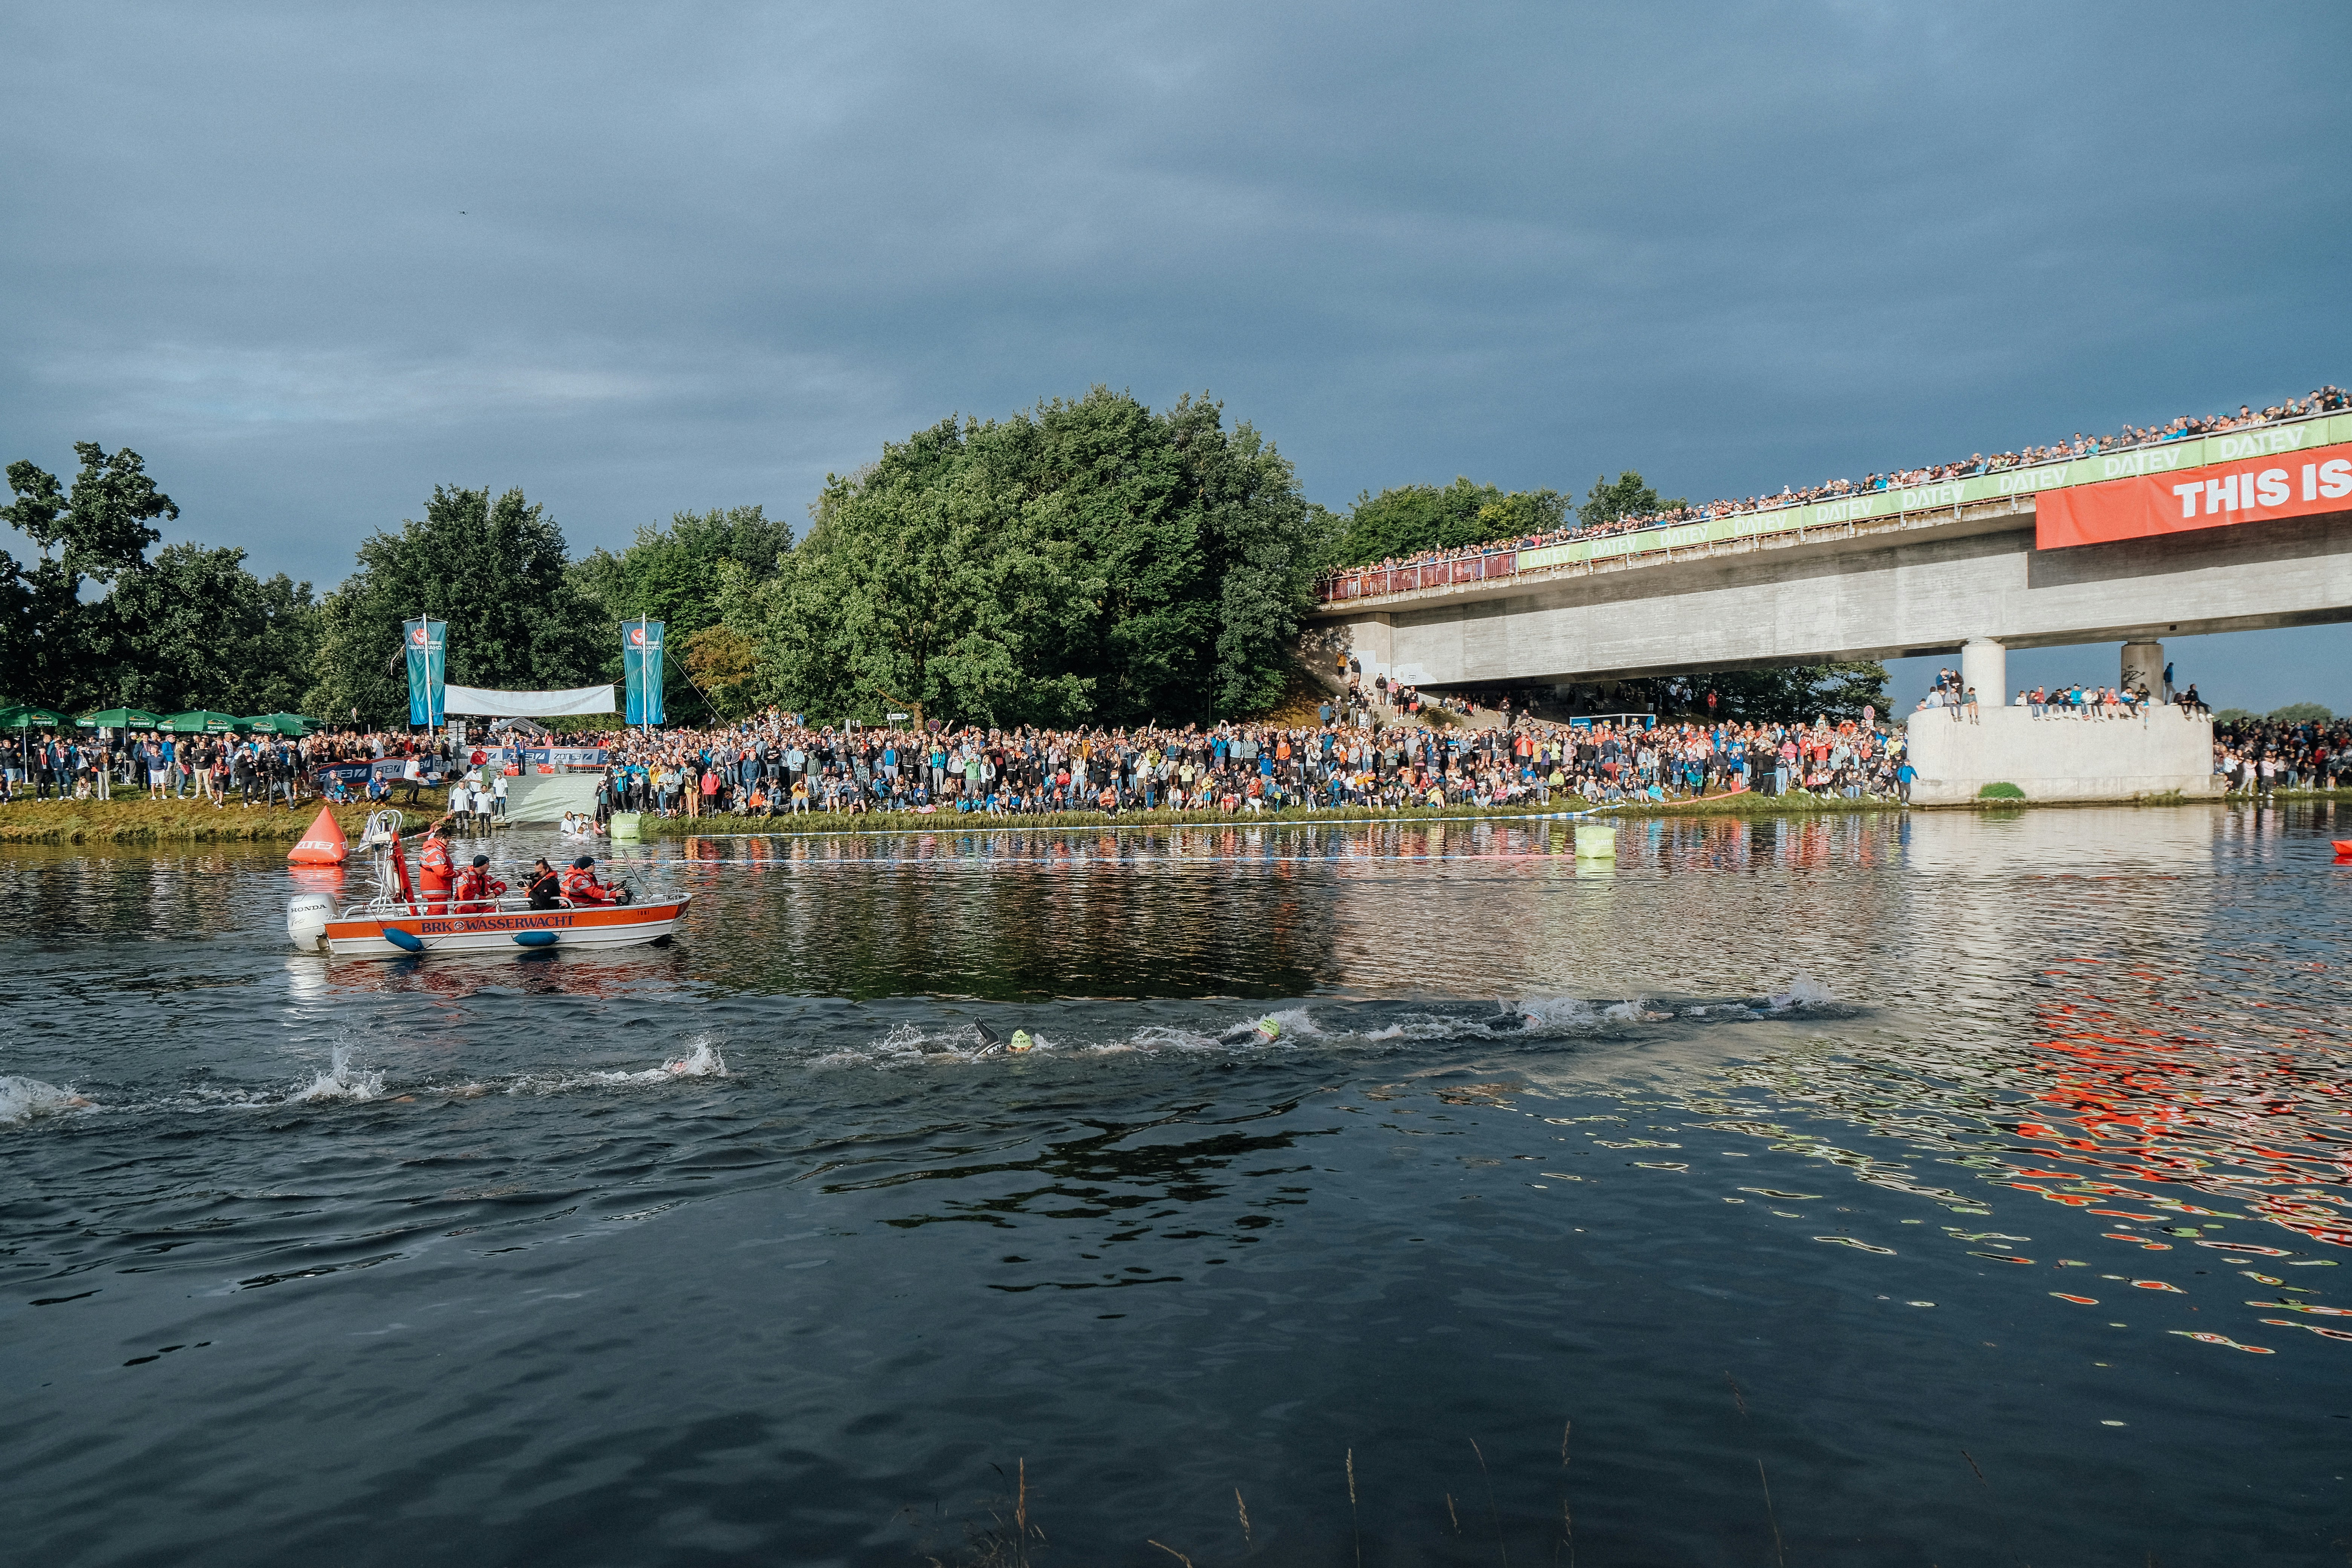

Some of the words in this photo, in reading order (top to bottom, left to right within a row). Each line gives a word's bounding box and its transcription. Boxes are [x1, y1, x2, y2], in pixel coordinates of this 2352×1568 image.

[2220, 426, 2306, 459] DATEV
[2105, 447, 2181, 477] DATEV
[2000, 466, 2068, 494] DATEV
[2174, 469, 2290, 518] THIS
[2303, 459, 2352, 501] IS
[1903, 482, 1965, 509] DATEV
[1816, 498, 1874, 522] DATEV
[1734, 512, 1788, 535] DATEV
[1592, 536, 1637, 557] DATEV
[1660, 525, 1709, 547] DATEV
[1529, 547, 1570, 566] DATEV
[296, 841, 334, 850] ZONE3
[291, 904, 327, 913] HONDA
[421, 922, 452, 933] BRK
[466, 916, 574, 931] WASSERWACHT
